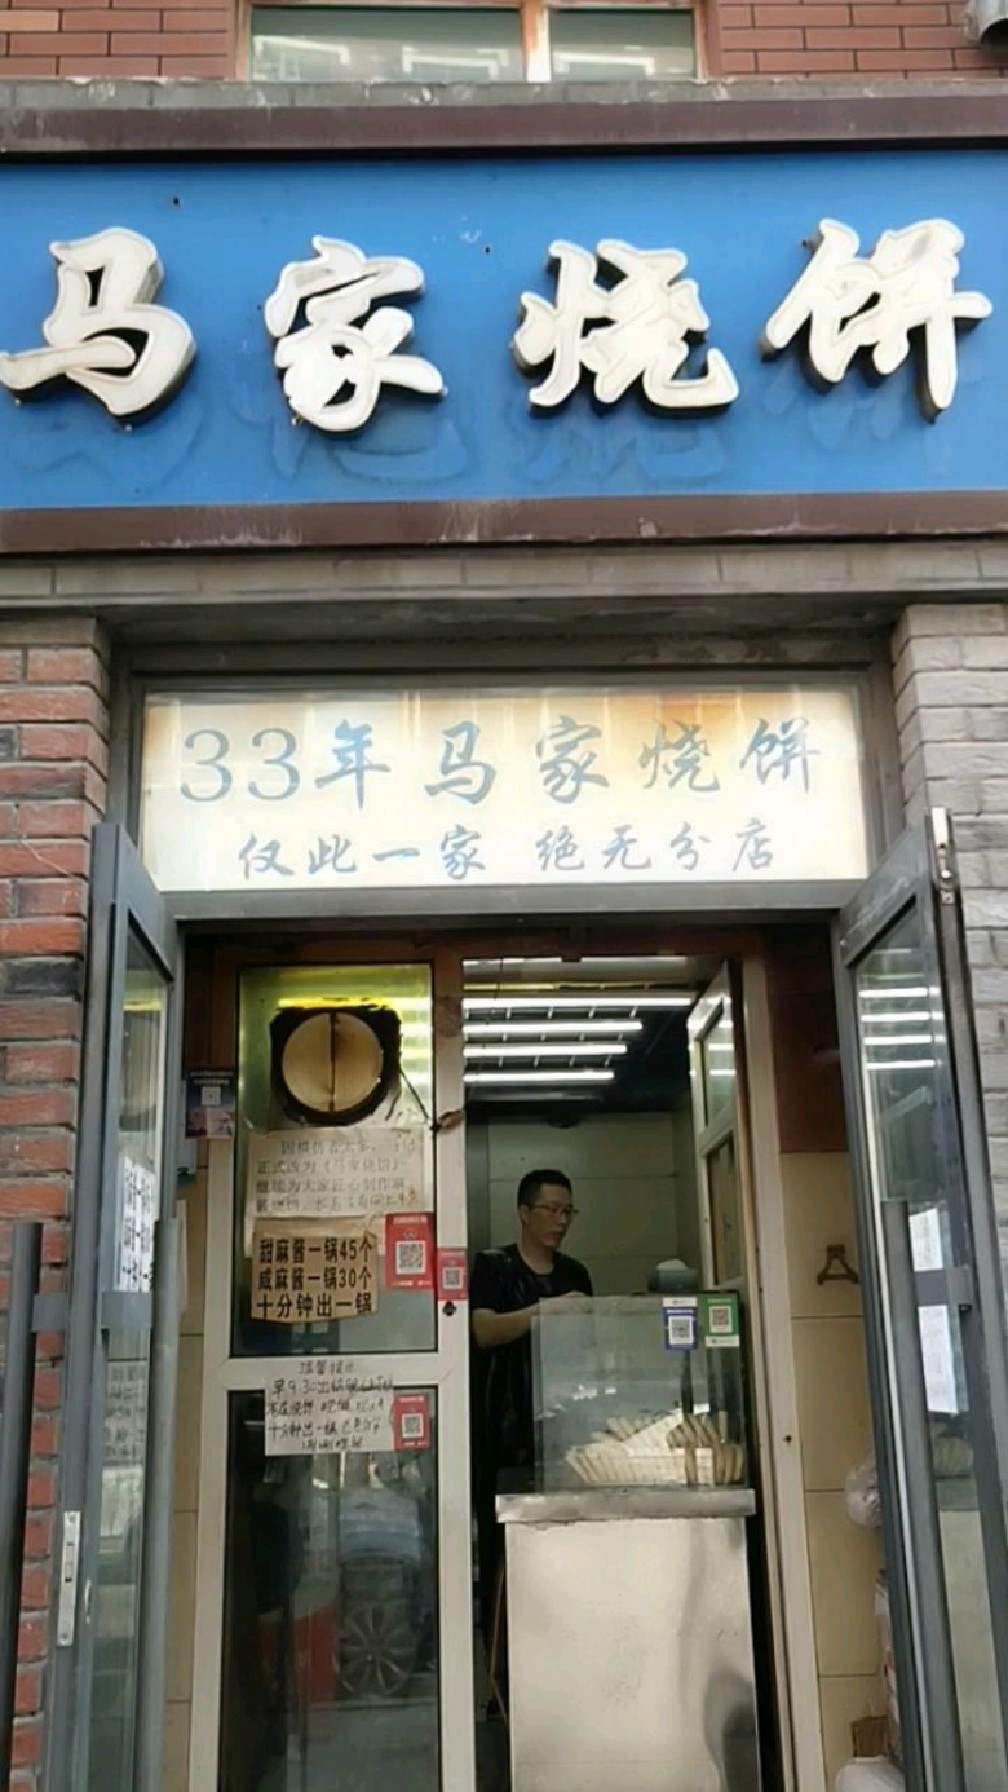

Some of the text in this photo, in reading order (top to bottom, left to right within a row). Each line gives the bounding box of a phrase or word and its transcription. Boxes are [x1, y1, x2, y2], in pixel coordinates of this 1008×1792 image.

[0, 218, 993, 432] 马家烧饼
[237, 818, 776, 880] 仅此一家 绝无分店
[259, 1236, 373, 1264] 甜麻酱一锅45个
[257, 1266, 373, 1291] 咸麻酱一锅30个
[257, 1292, 373, 1318] 十分钟出一锅
